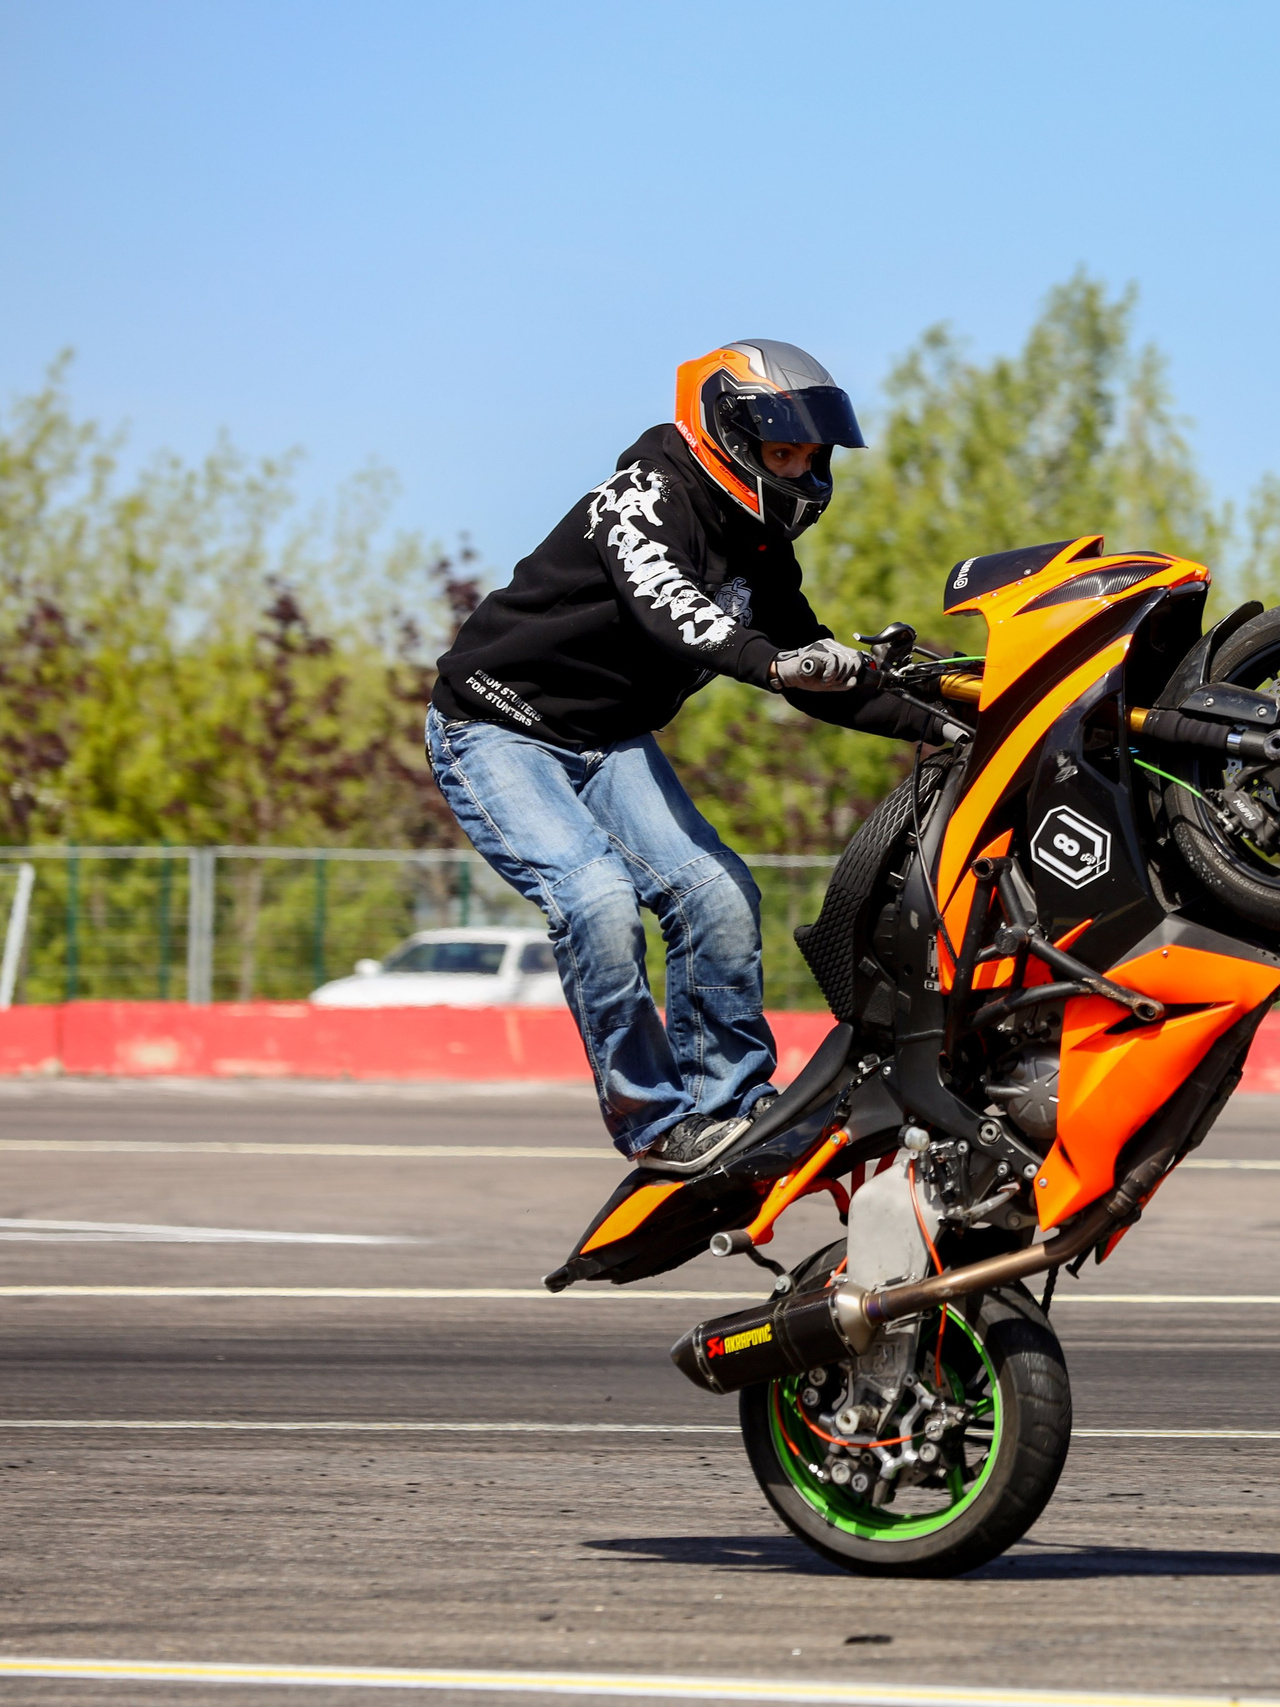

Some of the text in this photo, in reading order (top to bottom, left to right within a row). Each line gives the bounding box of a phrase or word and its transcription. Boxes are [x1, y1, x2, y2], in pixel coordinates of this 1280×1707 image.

[675, 420, 699, 448] AIROH
[465, 676, 533, 727] FOR STUNTERS
[474, 669, 543, 722] FROM STUNTERS
